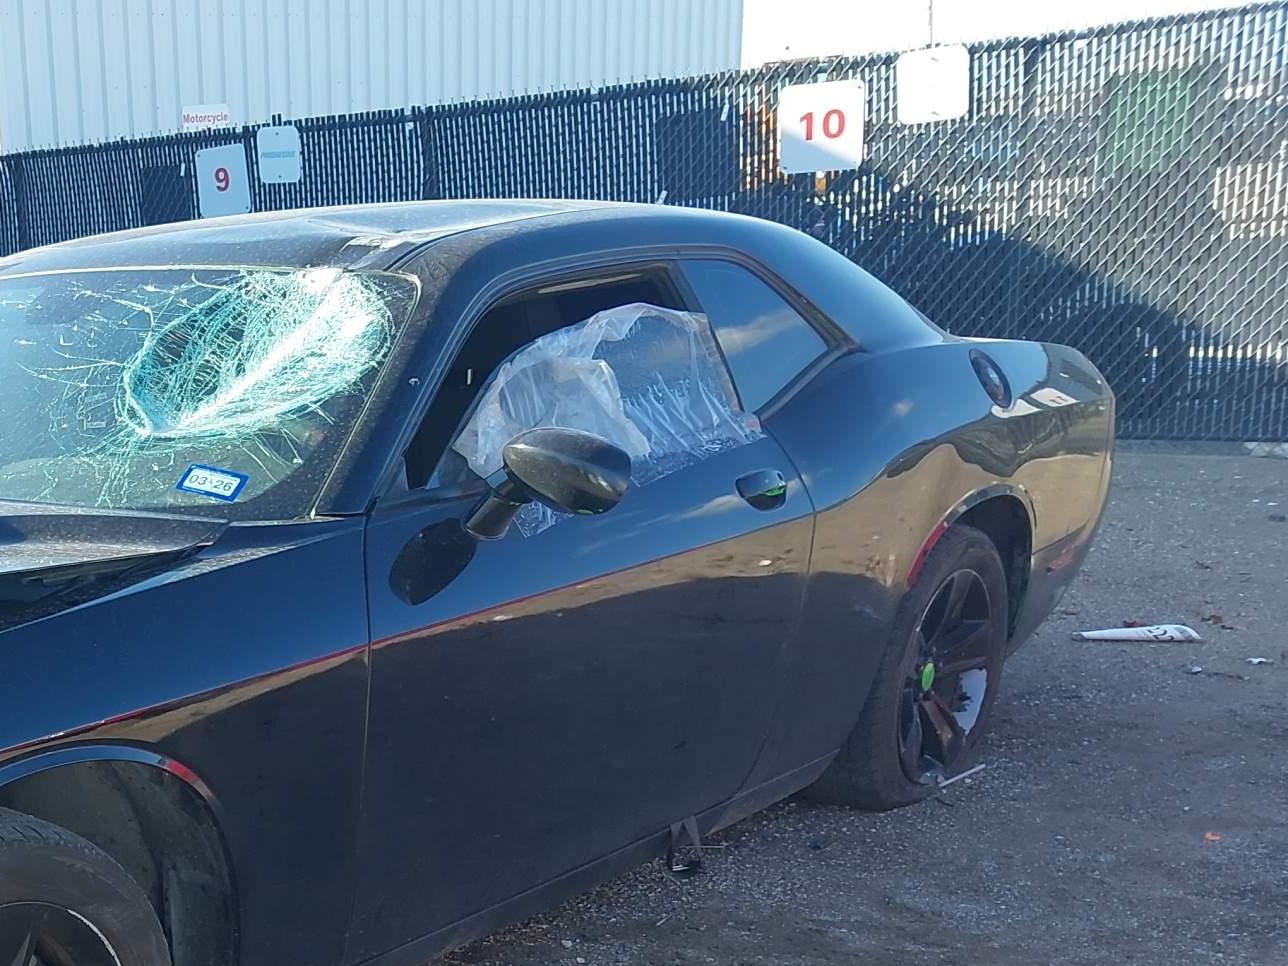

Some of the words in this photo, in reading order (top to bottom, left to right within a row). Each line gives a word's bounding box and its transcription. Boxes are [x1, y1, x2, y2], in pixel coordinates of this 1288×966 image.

[183, 112, 229, 124] Motorcycle
[799, 108, 846, 141] 10
[214, 167, 230, 192] 9
